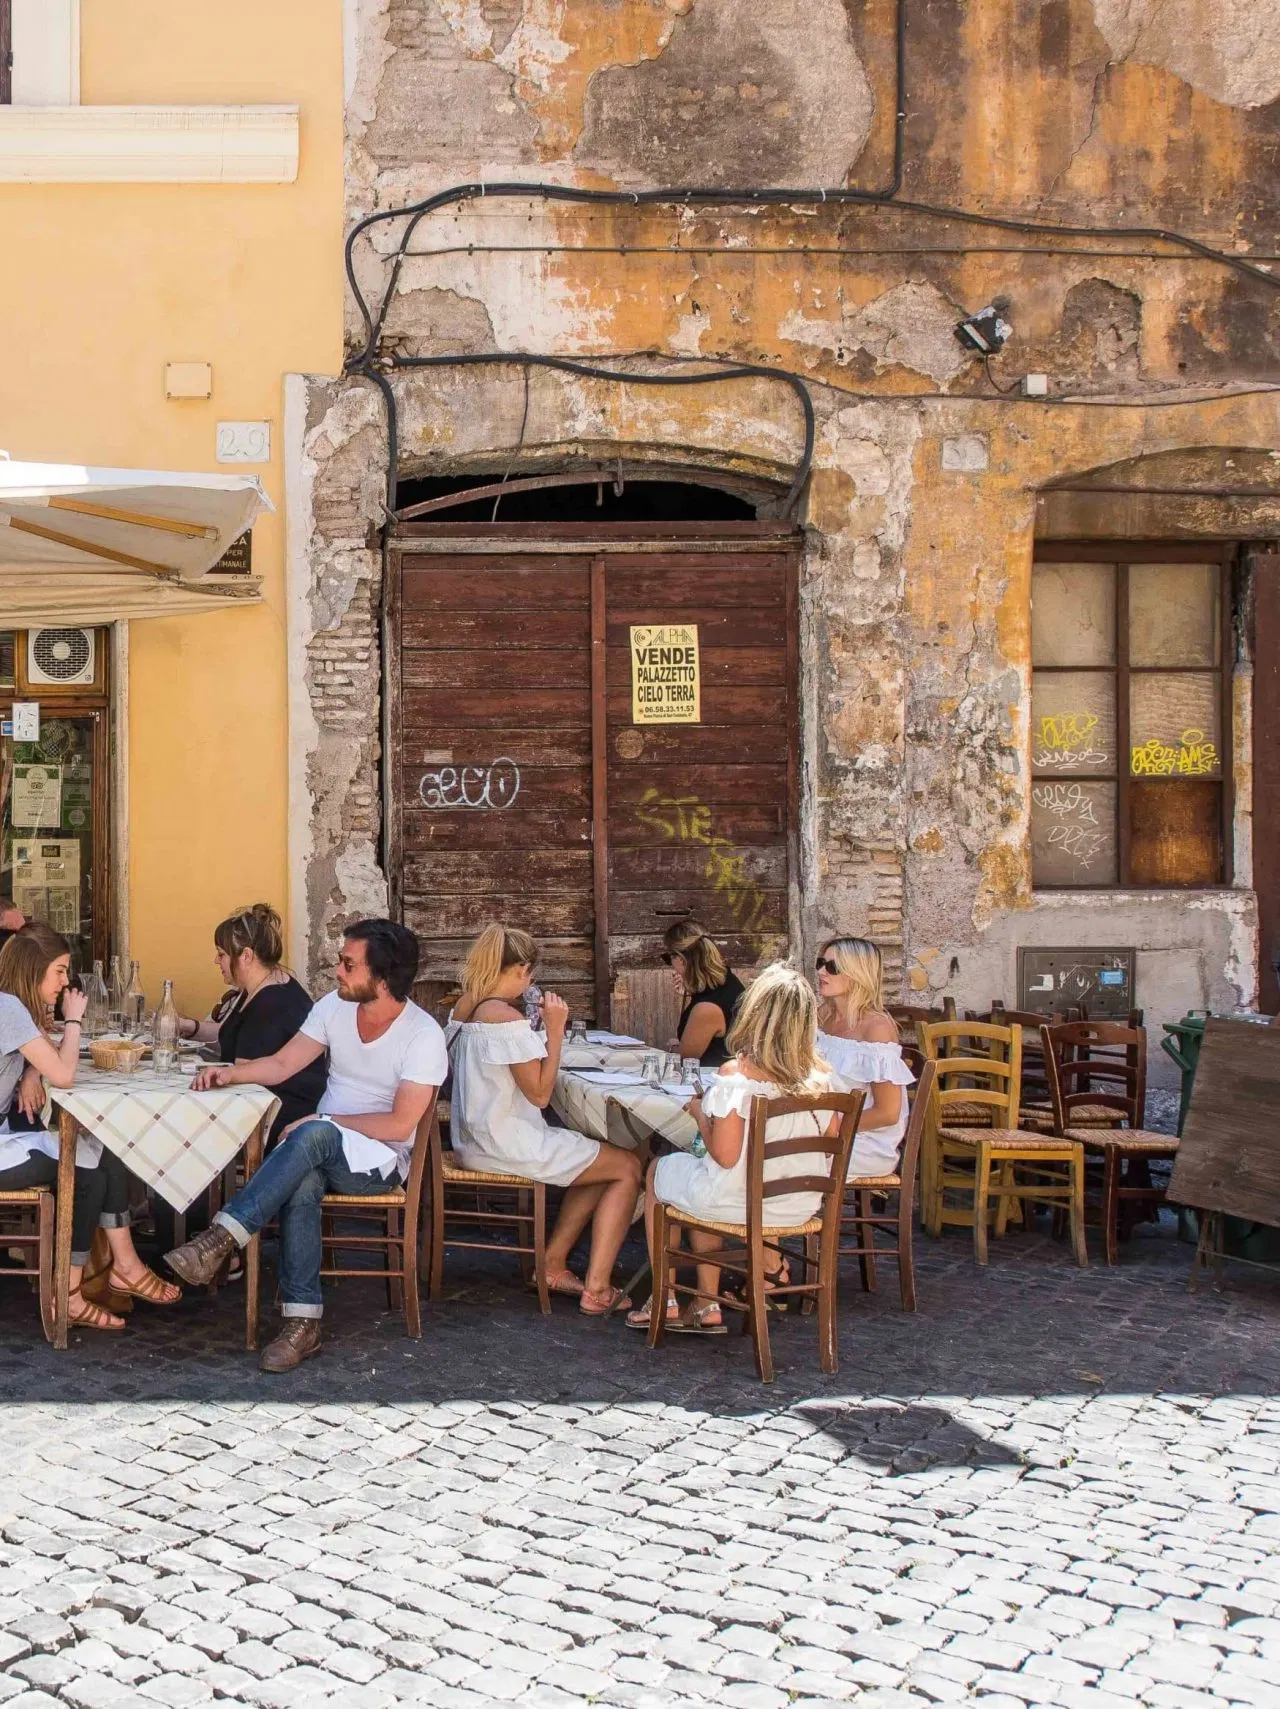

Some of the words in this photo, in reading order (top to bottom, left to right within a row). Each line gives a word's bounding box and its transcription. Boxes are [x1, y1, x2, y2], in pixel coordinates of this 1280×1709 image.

[635, 646, 696, 666] VENDE
[637, 666, 696, 683] PALAZZETTO
[637, 686, 663, 702] CIELO
[665, 685, 695, 702] TERRA
